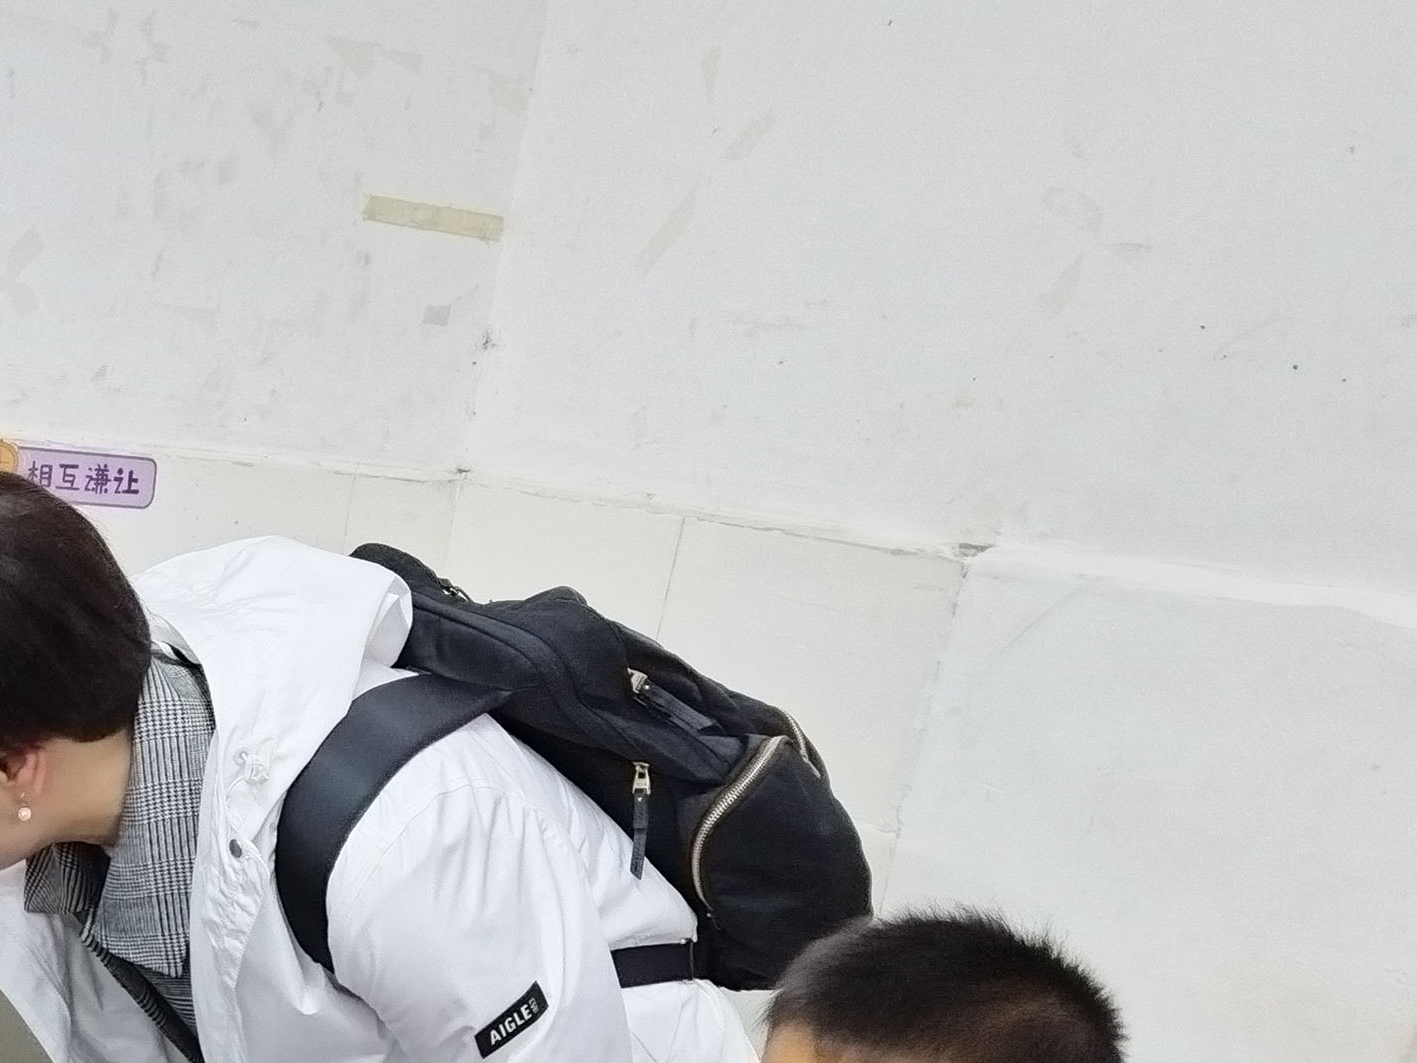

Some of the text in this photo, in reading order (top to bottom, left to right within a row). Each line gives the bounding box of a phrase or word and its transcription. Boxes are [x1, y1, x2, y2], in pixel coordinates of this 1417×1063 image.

[27, 460, 140, 495] 相互谦让
[489, 1003, 533, 1046] AIGLE
